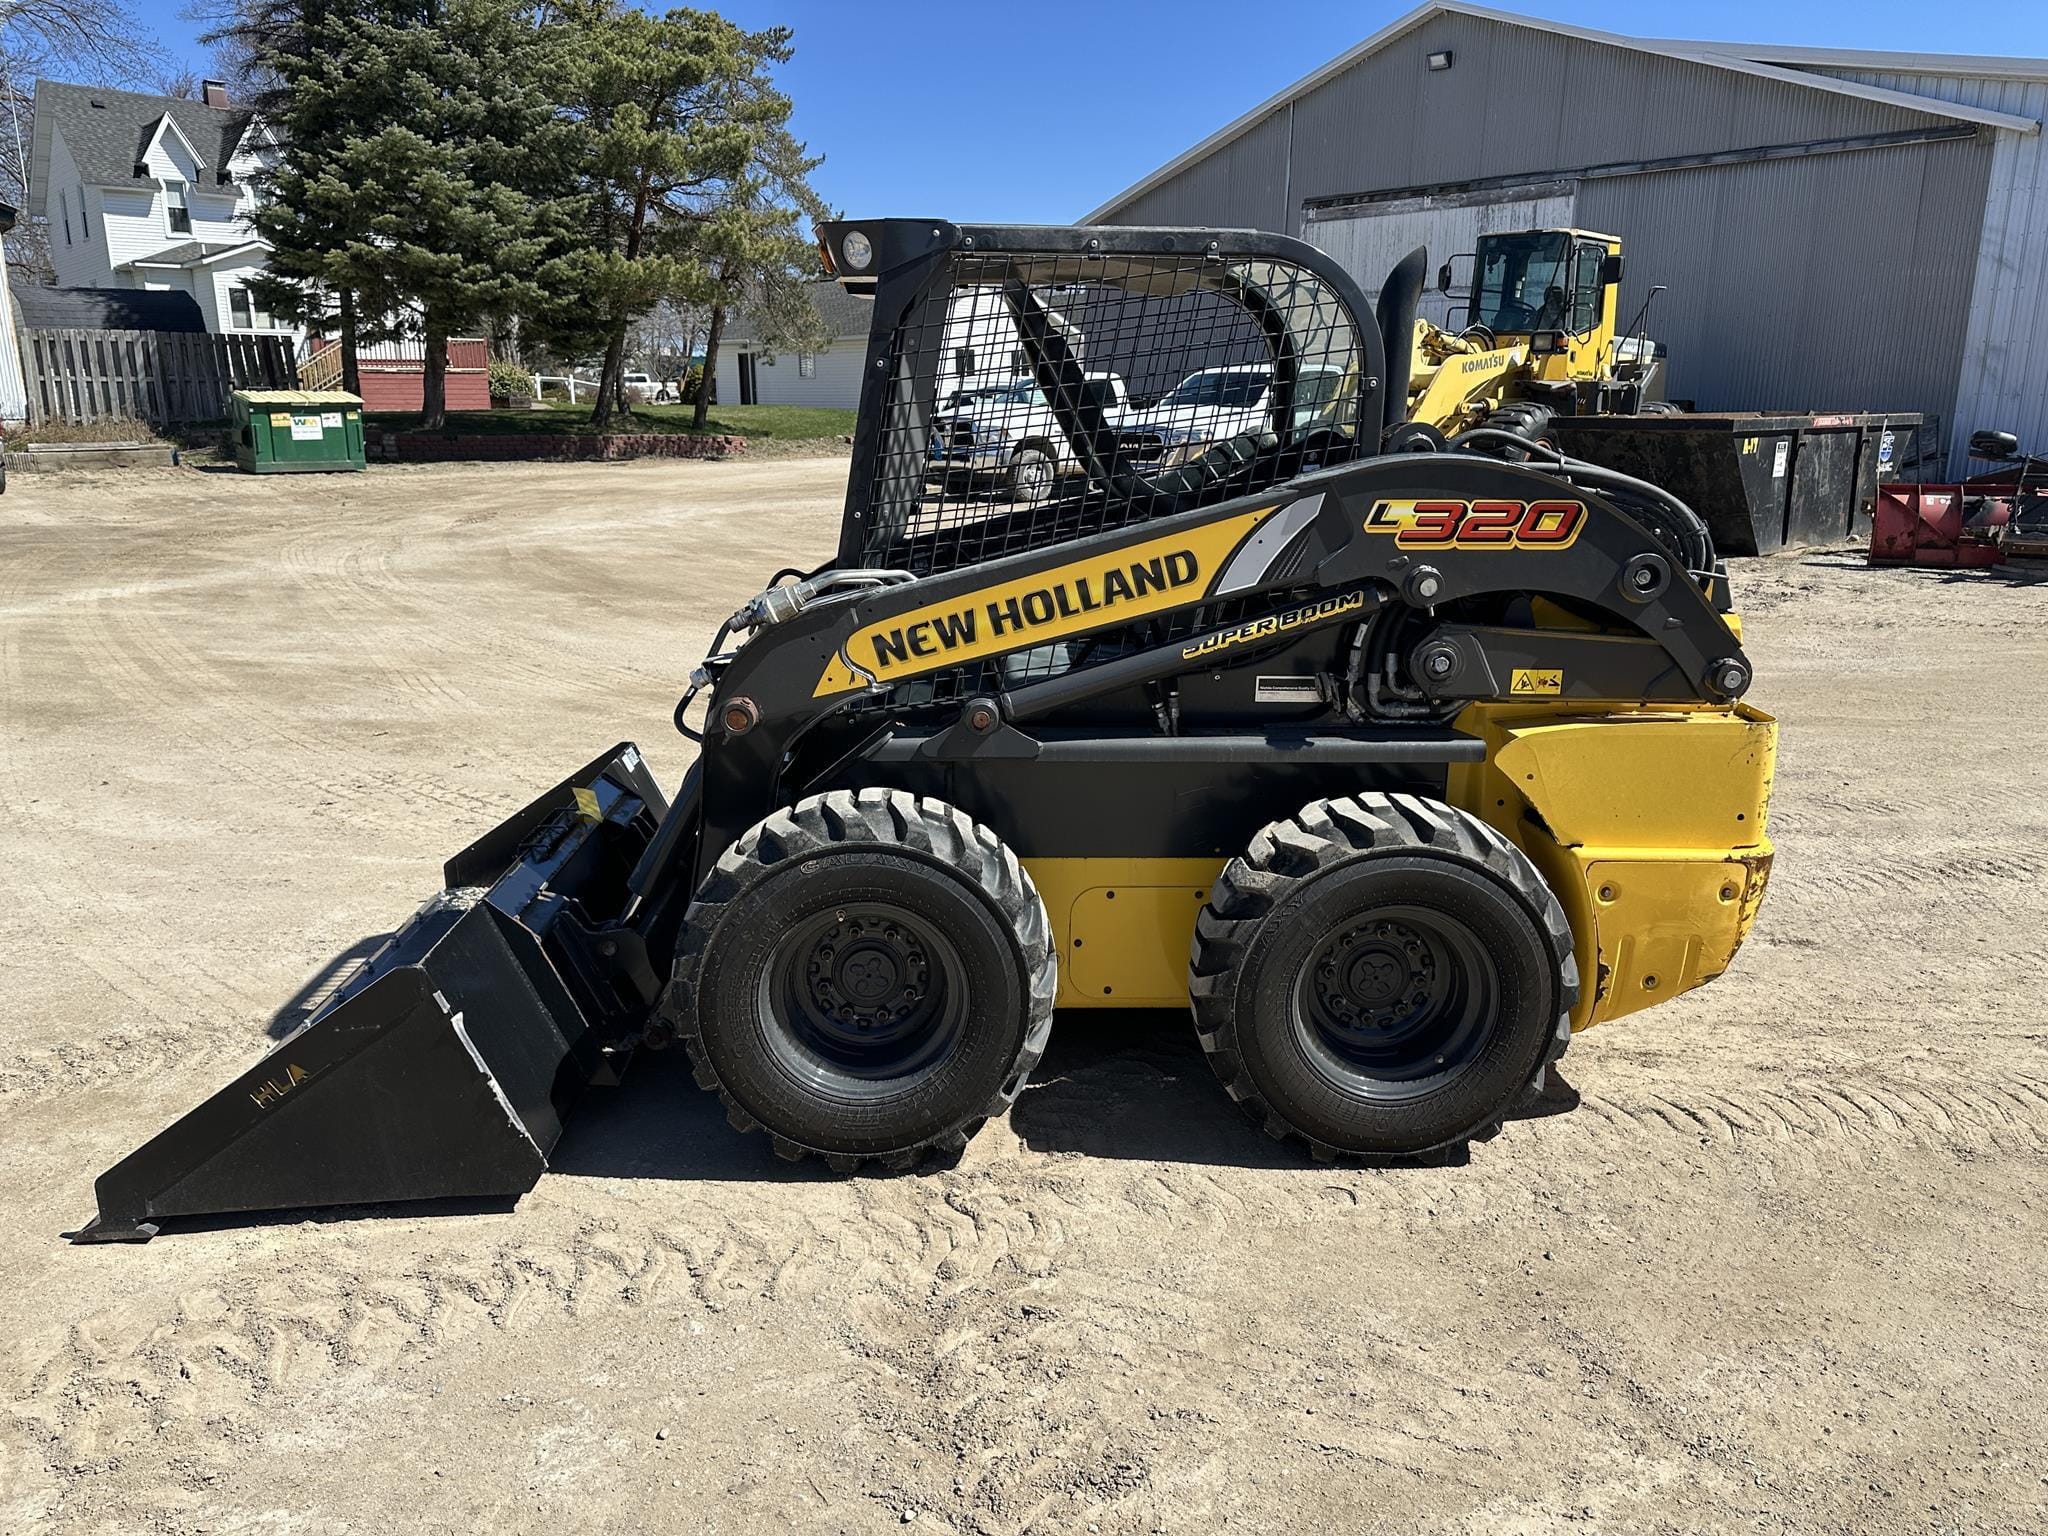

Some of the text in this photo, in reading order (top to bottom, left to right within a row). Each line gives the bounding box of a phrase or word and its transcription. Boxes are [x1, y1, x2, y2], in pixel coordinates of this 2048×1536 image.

[1461, 354, 1504, 374] KOMATSU
[870, 549, 1199, 667] NEW HOLLAND
[1182, 590, 1364, 659] SUPER BOOM
[800, 852, 928, 874] GALAXY
[249, 1063, 312, 1109] HLA
